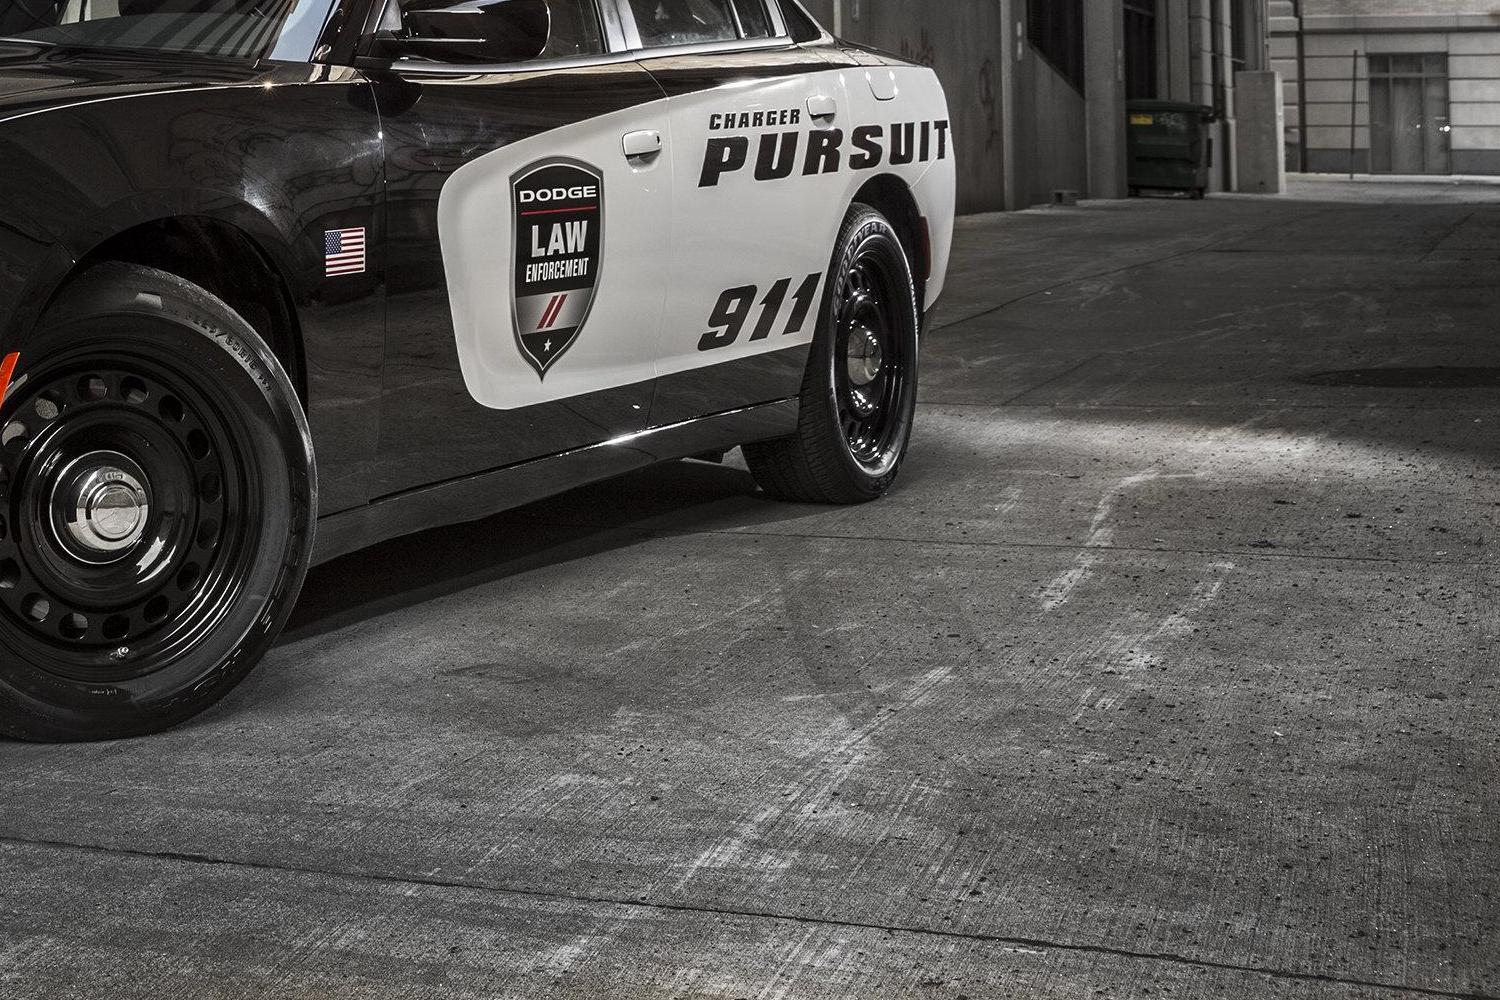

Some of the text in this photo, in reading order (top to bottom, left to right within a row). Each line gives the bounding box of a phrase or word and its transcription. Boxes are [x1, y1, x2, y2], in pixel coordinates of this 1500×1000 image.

[709, 109, 800, 130] CHARGER
[698, 120, 948, 187] PURSUIT
[519, 185, 597, 203] DODGE
[531, 220, 588, 258] LAW
[525, 257, 589, 283] ENFORCEMENT
[697, 272, 822, 352] 911
